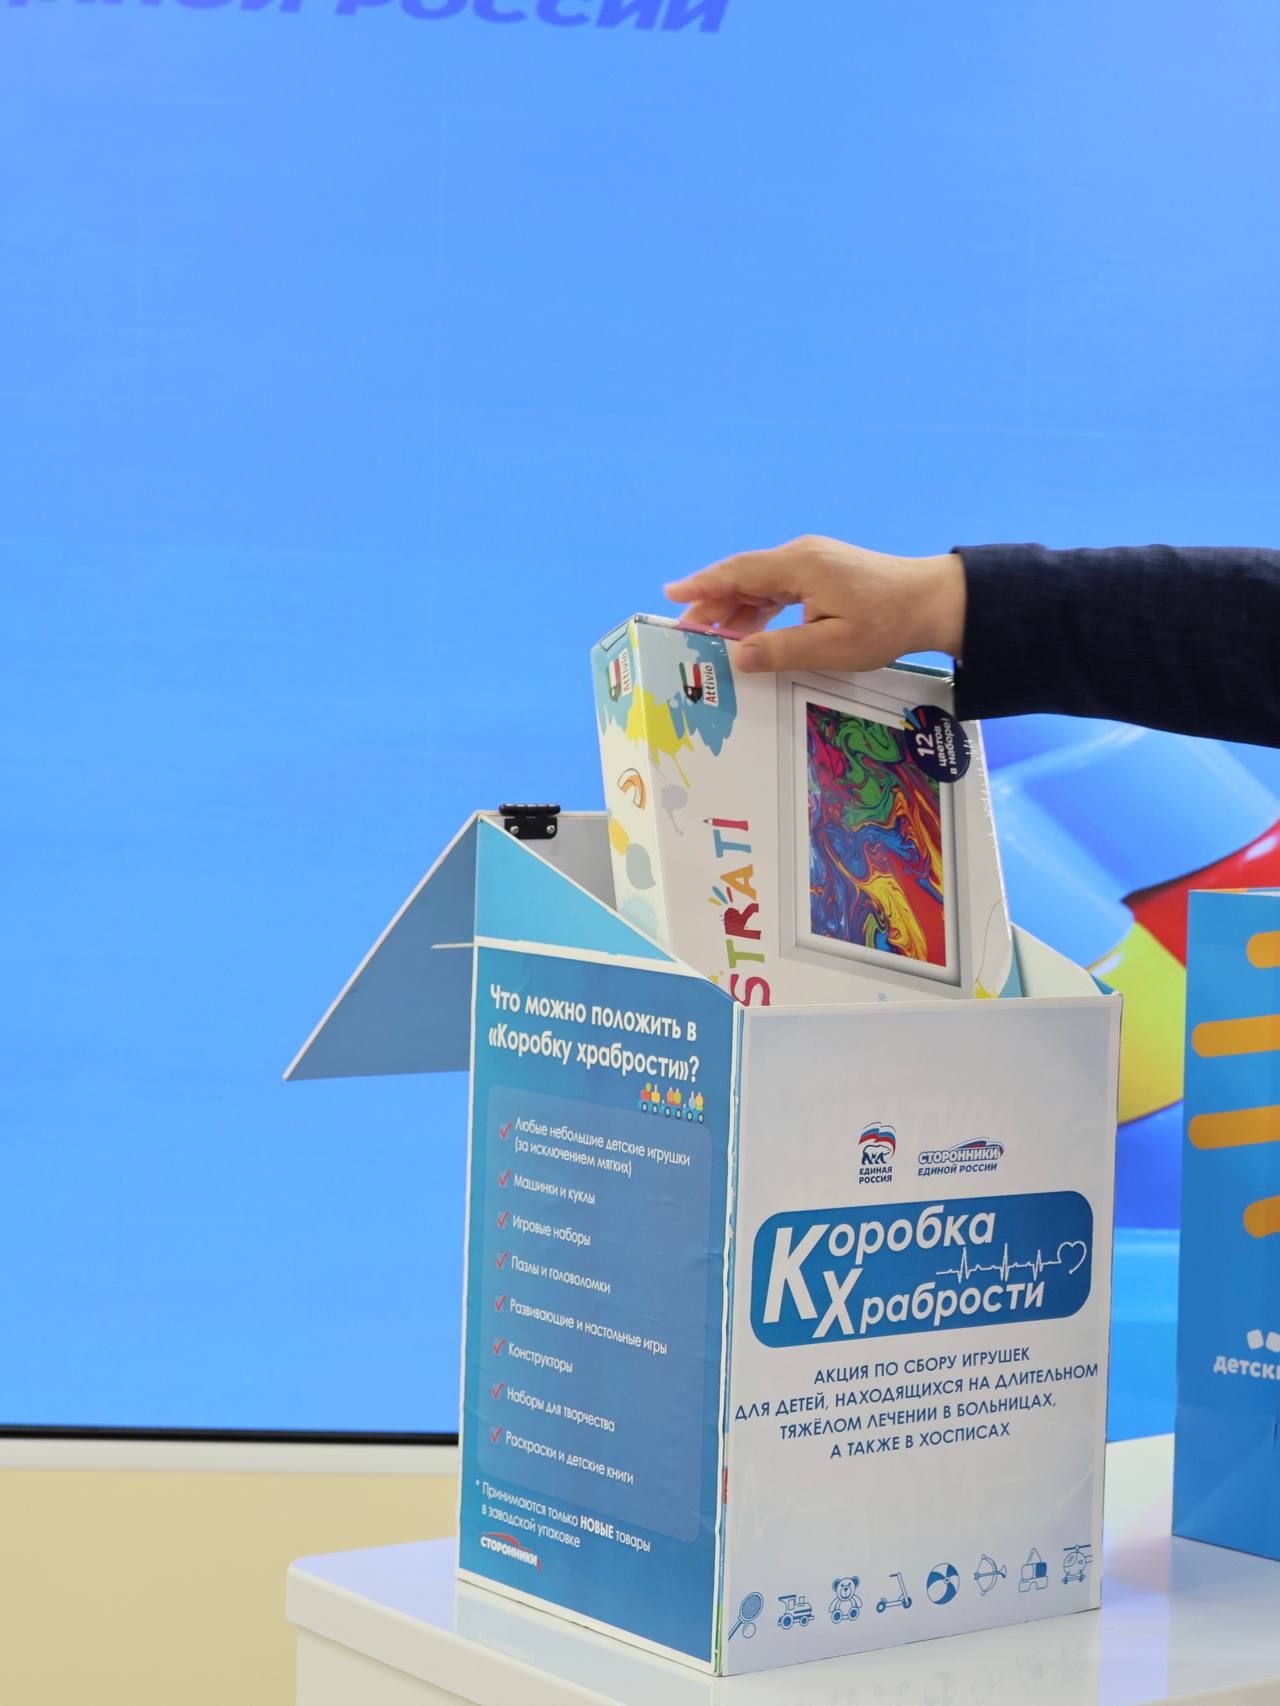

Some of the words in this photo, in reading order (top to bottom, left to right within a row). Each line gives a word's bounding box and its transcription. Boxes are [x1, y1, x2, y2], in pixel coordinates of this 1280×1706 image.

[703, 665, 717, 704] Attivio
[916, 733, 935, 757] 12
[934, 725, 948, 767] цветов
[941, 718, 957, 765] наборе!
[950, 767, 958, 775] в
[490, 984, 520, 1011] Что
[525, 996, 586, 1025] можно
[592, 1005, 681, 1039] положить
[687, 1022, 697, 1042] в
[488, 1024, 572, 1065] «Коробку
[576, 1042, 700, 1082] храбрости»?
[515, 1117, 548, 1137] Любые
[550, 1124, 604, 1148] небольшие
[606, 1137, 645, 1157] детские
[647, 1146, 690, 1167] игрушки
[515, 1136, 529, 1153] (за
[530, 1141, 596, 1167] исключением
[597, 1157, 633, 1178] мягких)
[918, 1148, 999, 1165] СТОРОННИКИ
[513, 1174, 558, 1196] Машинки
[560, 1188, 567, 1197] и
[568, 1190, 596, 1205] куклы
[859, 1166, 893, 1175] ЕДИНАЯ
[859, 1174, 893, 1184] РОССИЯ
[917, 1164, 958, 1177] ЕДИНОЙ
[959, 1163, 998, 1174] РОССИИ
[512, 1214, 551, 1238] Игровые
[553, 1226, 591, 1247] наборы
[511, 1255, 539, 1275] Пазлы
[541, 1267, 547, 1278] и
[549, 1269, 611, 1295] головоломки
[762, 1204, 996, 1324] Коробка
[812, 1266, 1045, 1338] Храбрости
[510, 1298, 575, 1330] Развивающие
[576, 1320, 583, 1331] и
[585, 1322, 641, 1349] настольные
[643, 1340, 667, 1356] игры
[508, 1342, 573, 1374] Конструкторы
[814, 1363, 869, 1385] АКЦИЯ
[874, 1360, 899, 1378] ПО
[903, 1354, 957, 1375] СБОРУ
[962, 1346, 1030, 1368] ИГРУШЕК
[507, 1387, 544, 1411] Наборы
[546, 1402, 562, 1416] для
[563, 1407, 615, 1433] творчества
[734, 1404, 770, 1421] ДЛЯ
[775, 1391, 829, 1416] ДЕТЕЙ,
[834, 1380, 963, 1408] НАХОДЯЩИХСЯ
[968, 1374, 990, 1391] НА
[994, 1363, 1099, 1391] ДЛИТЕЛЬНОМ
[780, 1416, 862, 1440] ТЯЖЁЛОМ
[867, 1408, 938, 1429] ЛЕЧЕНИИ
[943, 1406, 952, 1420] В
[956, 1393, 1057, 1419] БОЛЬНИЦАХ,
[505, 1430, 557, 1460] Раскраски
[558, 1451, 565, 1462] и
[566, 1455, 606, 1477] детские
[607, 1466, 634, 1486] книги
[830, 1444, 842, 1459] А
[847, 1436, 900, 1457] ТАКЖЕ
[905, 1435, 914, 1449] В
[919, 1422, 1011, 1447] ХОСПИСАХ
[481, 1504, 487, 1516] в
[488, 1507, 536, 1534] заводской
[537, 1524, 581, 1549] упаковке
[482, 1480, 546, 1517] Принимаются
[548, 1503, 579, 1528] только
[580, 1515, 614, 1541] НОВЫЕ
[616, 1529, 651, 1553] товары
